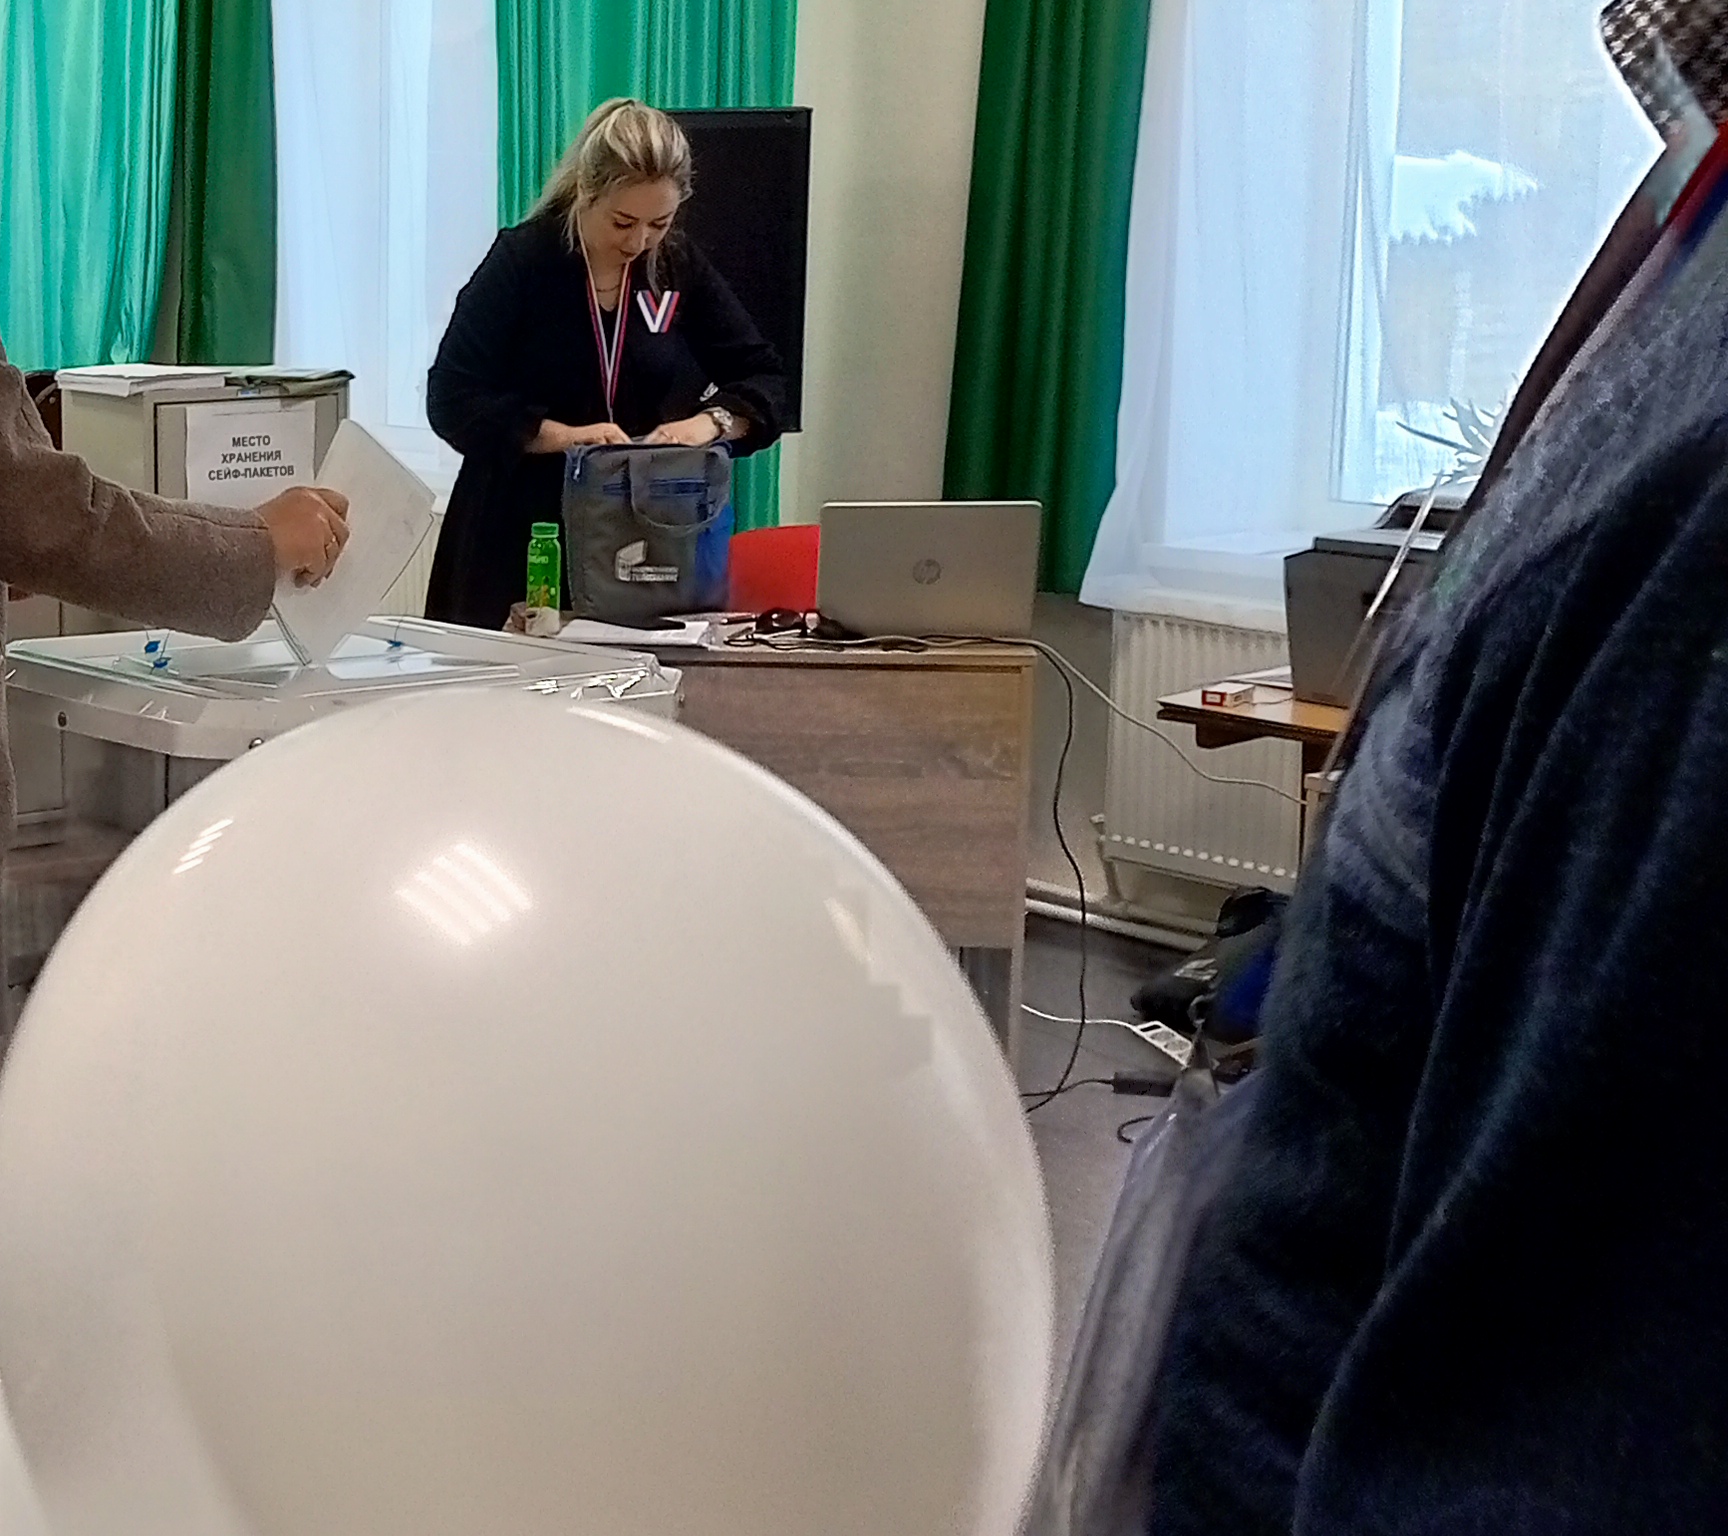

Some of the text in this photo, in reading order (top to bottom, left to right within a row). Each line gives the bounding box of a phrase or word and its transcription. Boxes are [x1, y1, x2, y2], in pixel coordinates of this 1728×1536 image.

[232, 435, 271, 447] МЕСТО
[221, 450, 282, 464] ХРАНЕНИЯ
[208, 465, 295, 481] СЕЙФ-ПАКЕТОВ
